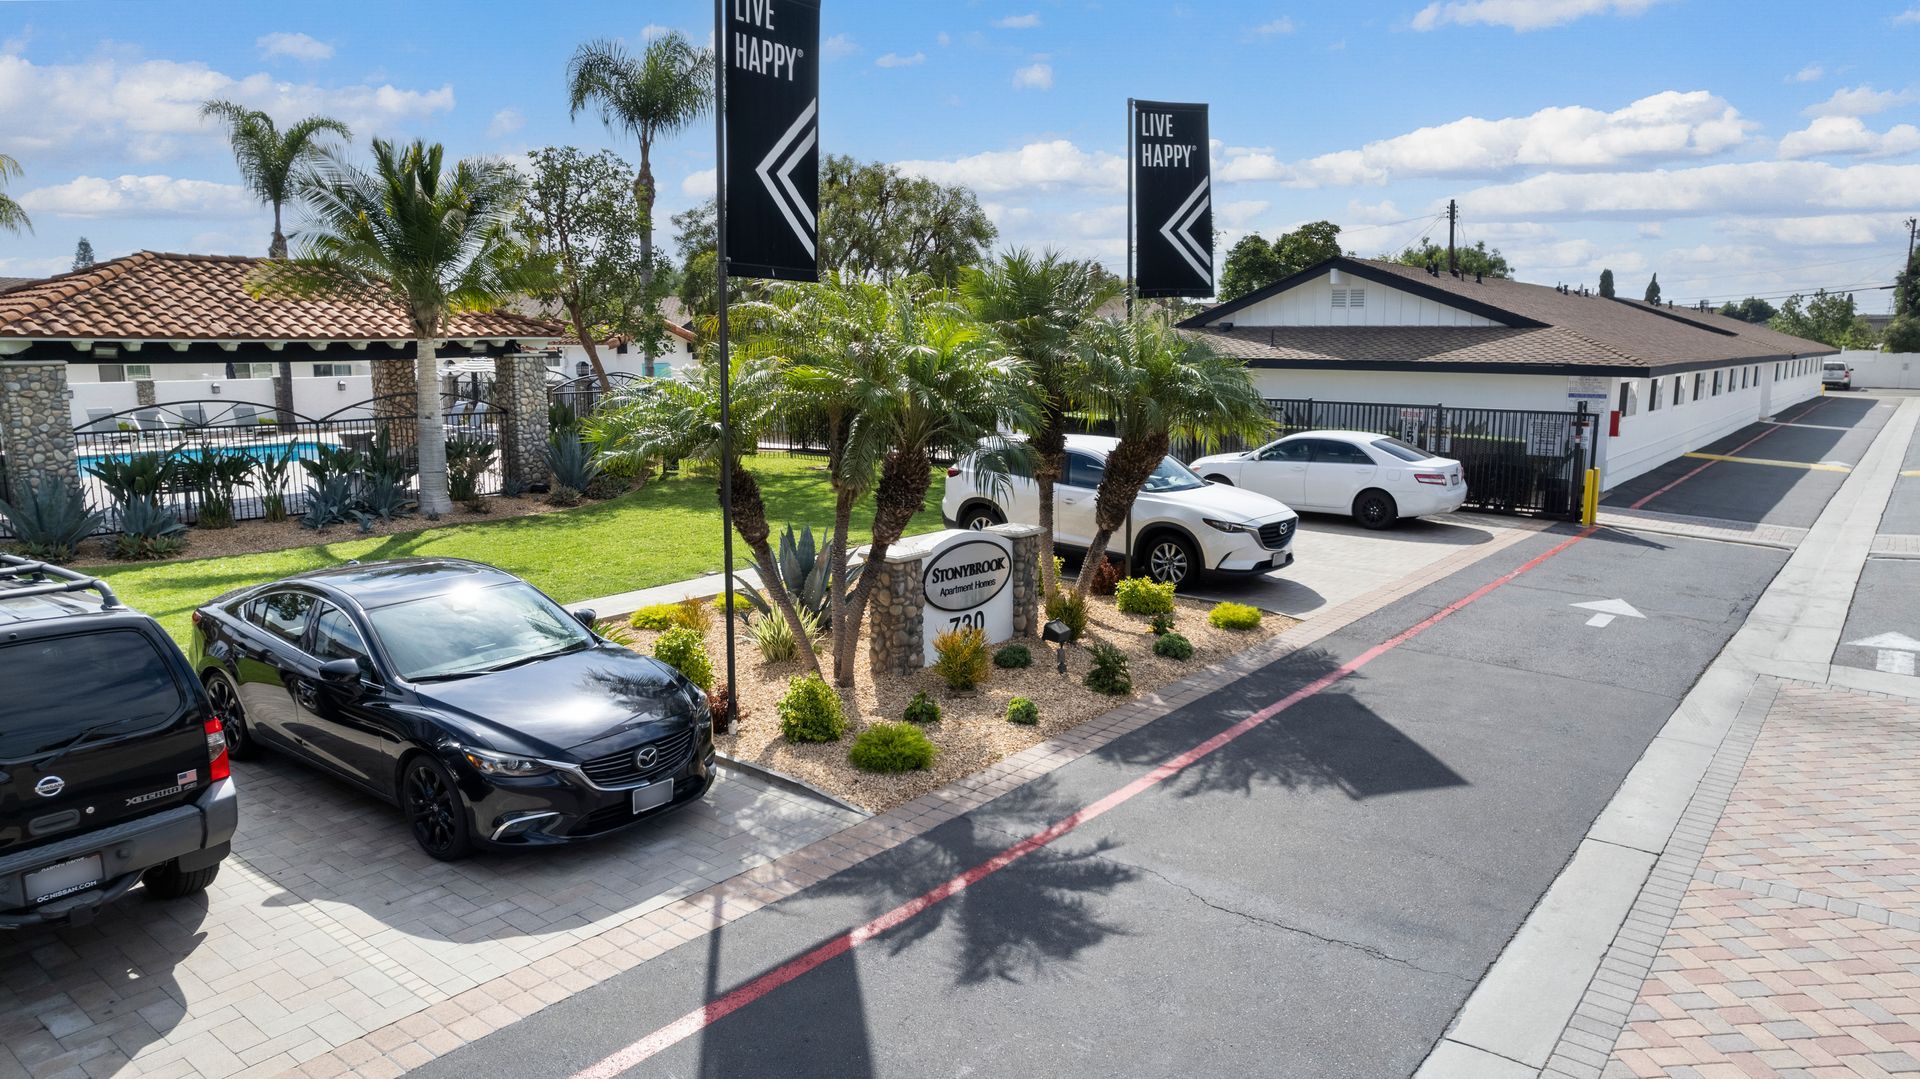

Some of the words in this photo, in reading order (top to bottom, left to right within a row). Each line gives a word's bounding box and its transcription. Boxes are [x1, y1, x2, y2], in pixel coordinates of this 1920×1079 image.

[735, 0, 775, 30] LIVE
[1142, 112, 1174, 138] LIVE
[932, 556, 1006, 584] STONYBROOK
[940, 582, 974, 598] Apartment
[974, 578, 996, 591] Homes
[125, 785, 182, 807] XTERRA
[36, 894, 49, 903] OC
[49, 880, 97, 899] NISSAN.COM
